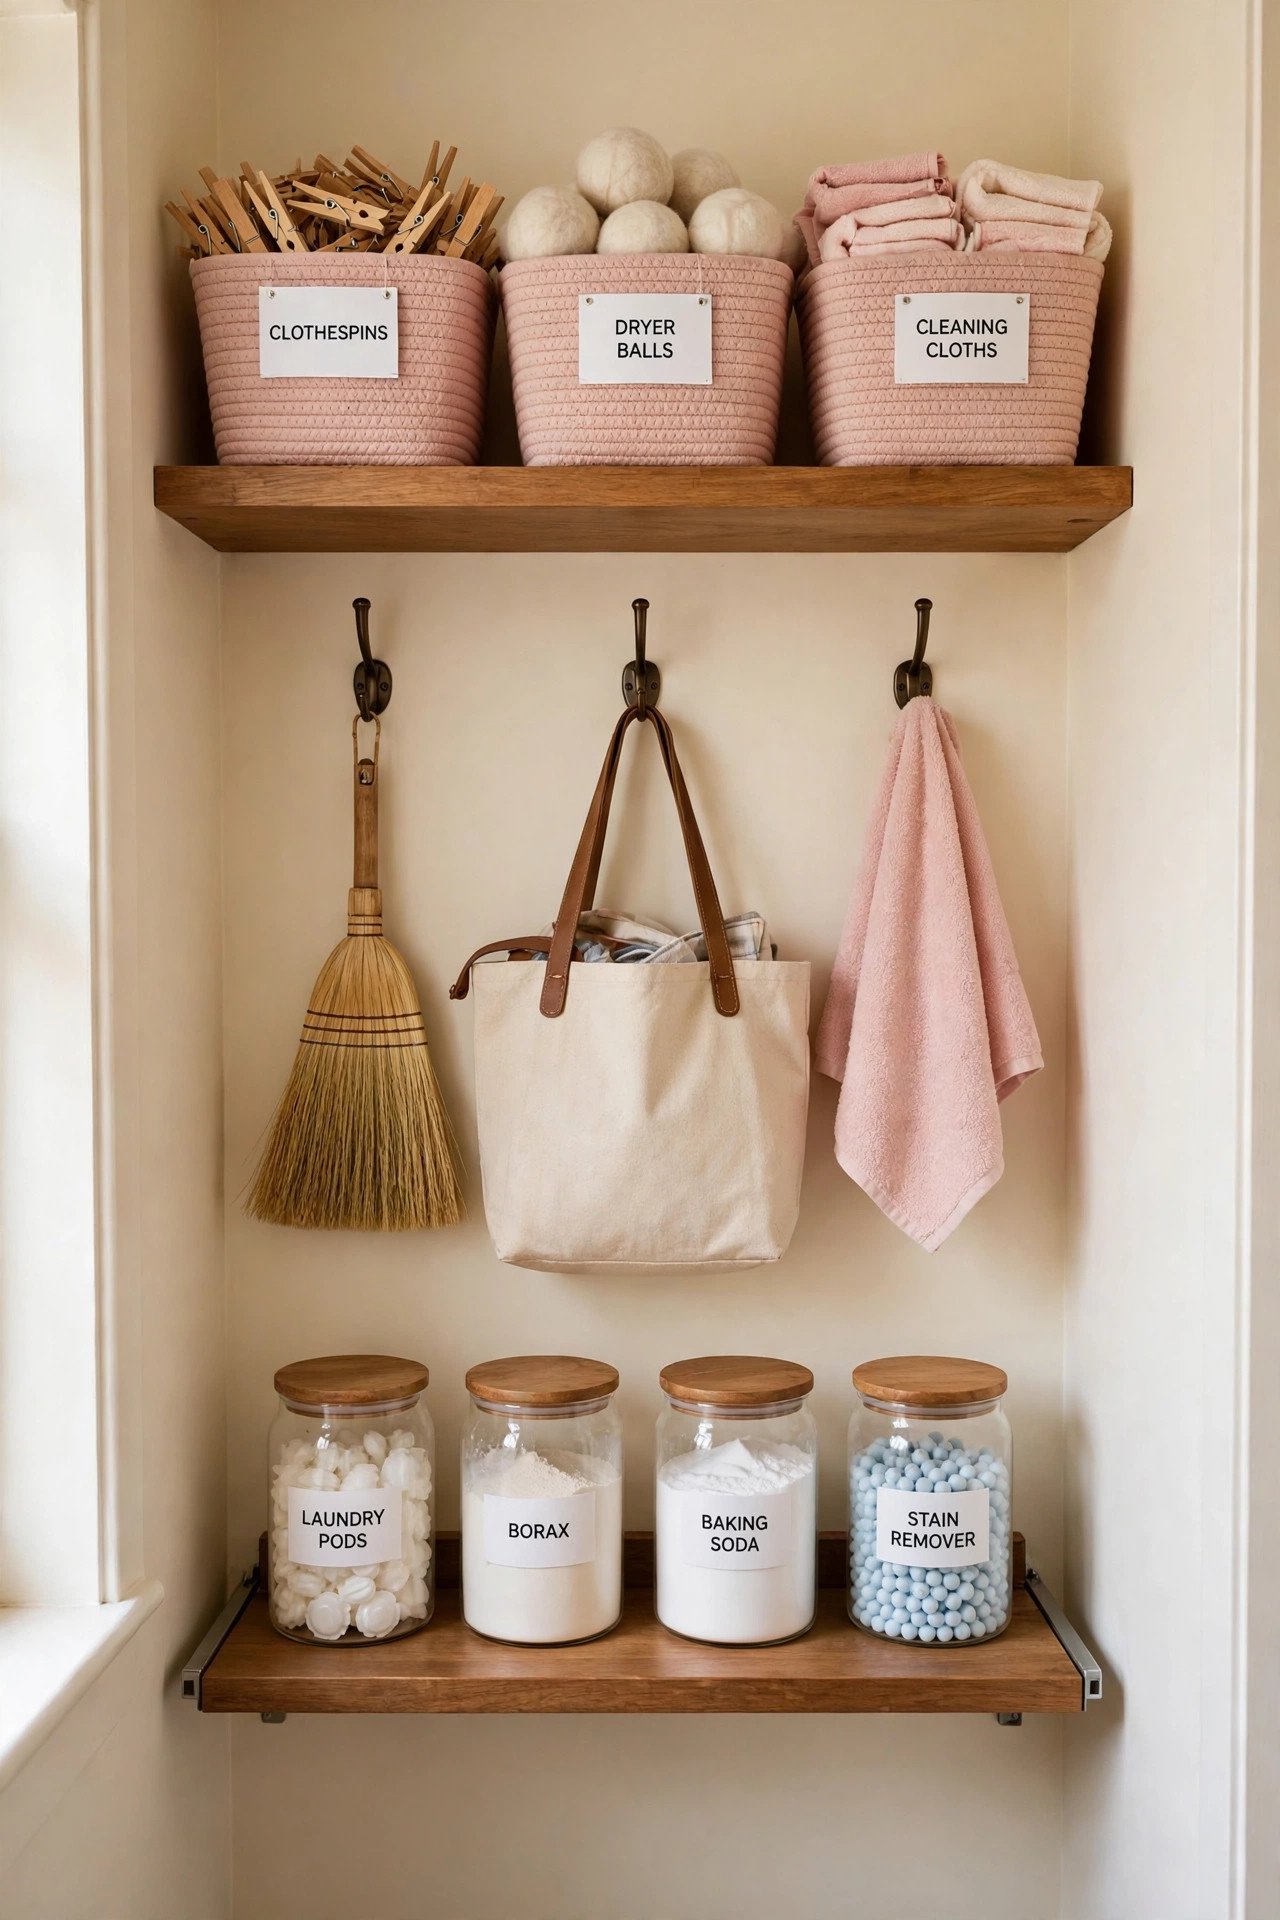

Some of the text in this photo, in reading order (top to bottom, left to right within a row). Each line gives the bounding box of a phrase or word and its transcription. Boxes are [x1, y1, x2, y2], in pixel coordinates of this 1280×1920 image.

[269, 324, 388, 341] CLOTHESPINS
[615, 319, 676, 336] DRYER
[916, 318, 1008, 335] CLEANING
[617, 342, 674, 359] BALLS
[926, 341, 998, 359] CLOTHS
[302, 1508, 386, 1528] LAUNDRY
[701, 1514, 768, 1532] BAKING
[907, 1511, 959, 1528] STAIN
[508, 1522, 570, 1540] BORAX
[891, 1530, 976, 1549] REMOVER
[319, 1532, 368, 1550] PODS
[710, 1536, 760, 1553] SODA
